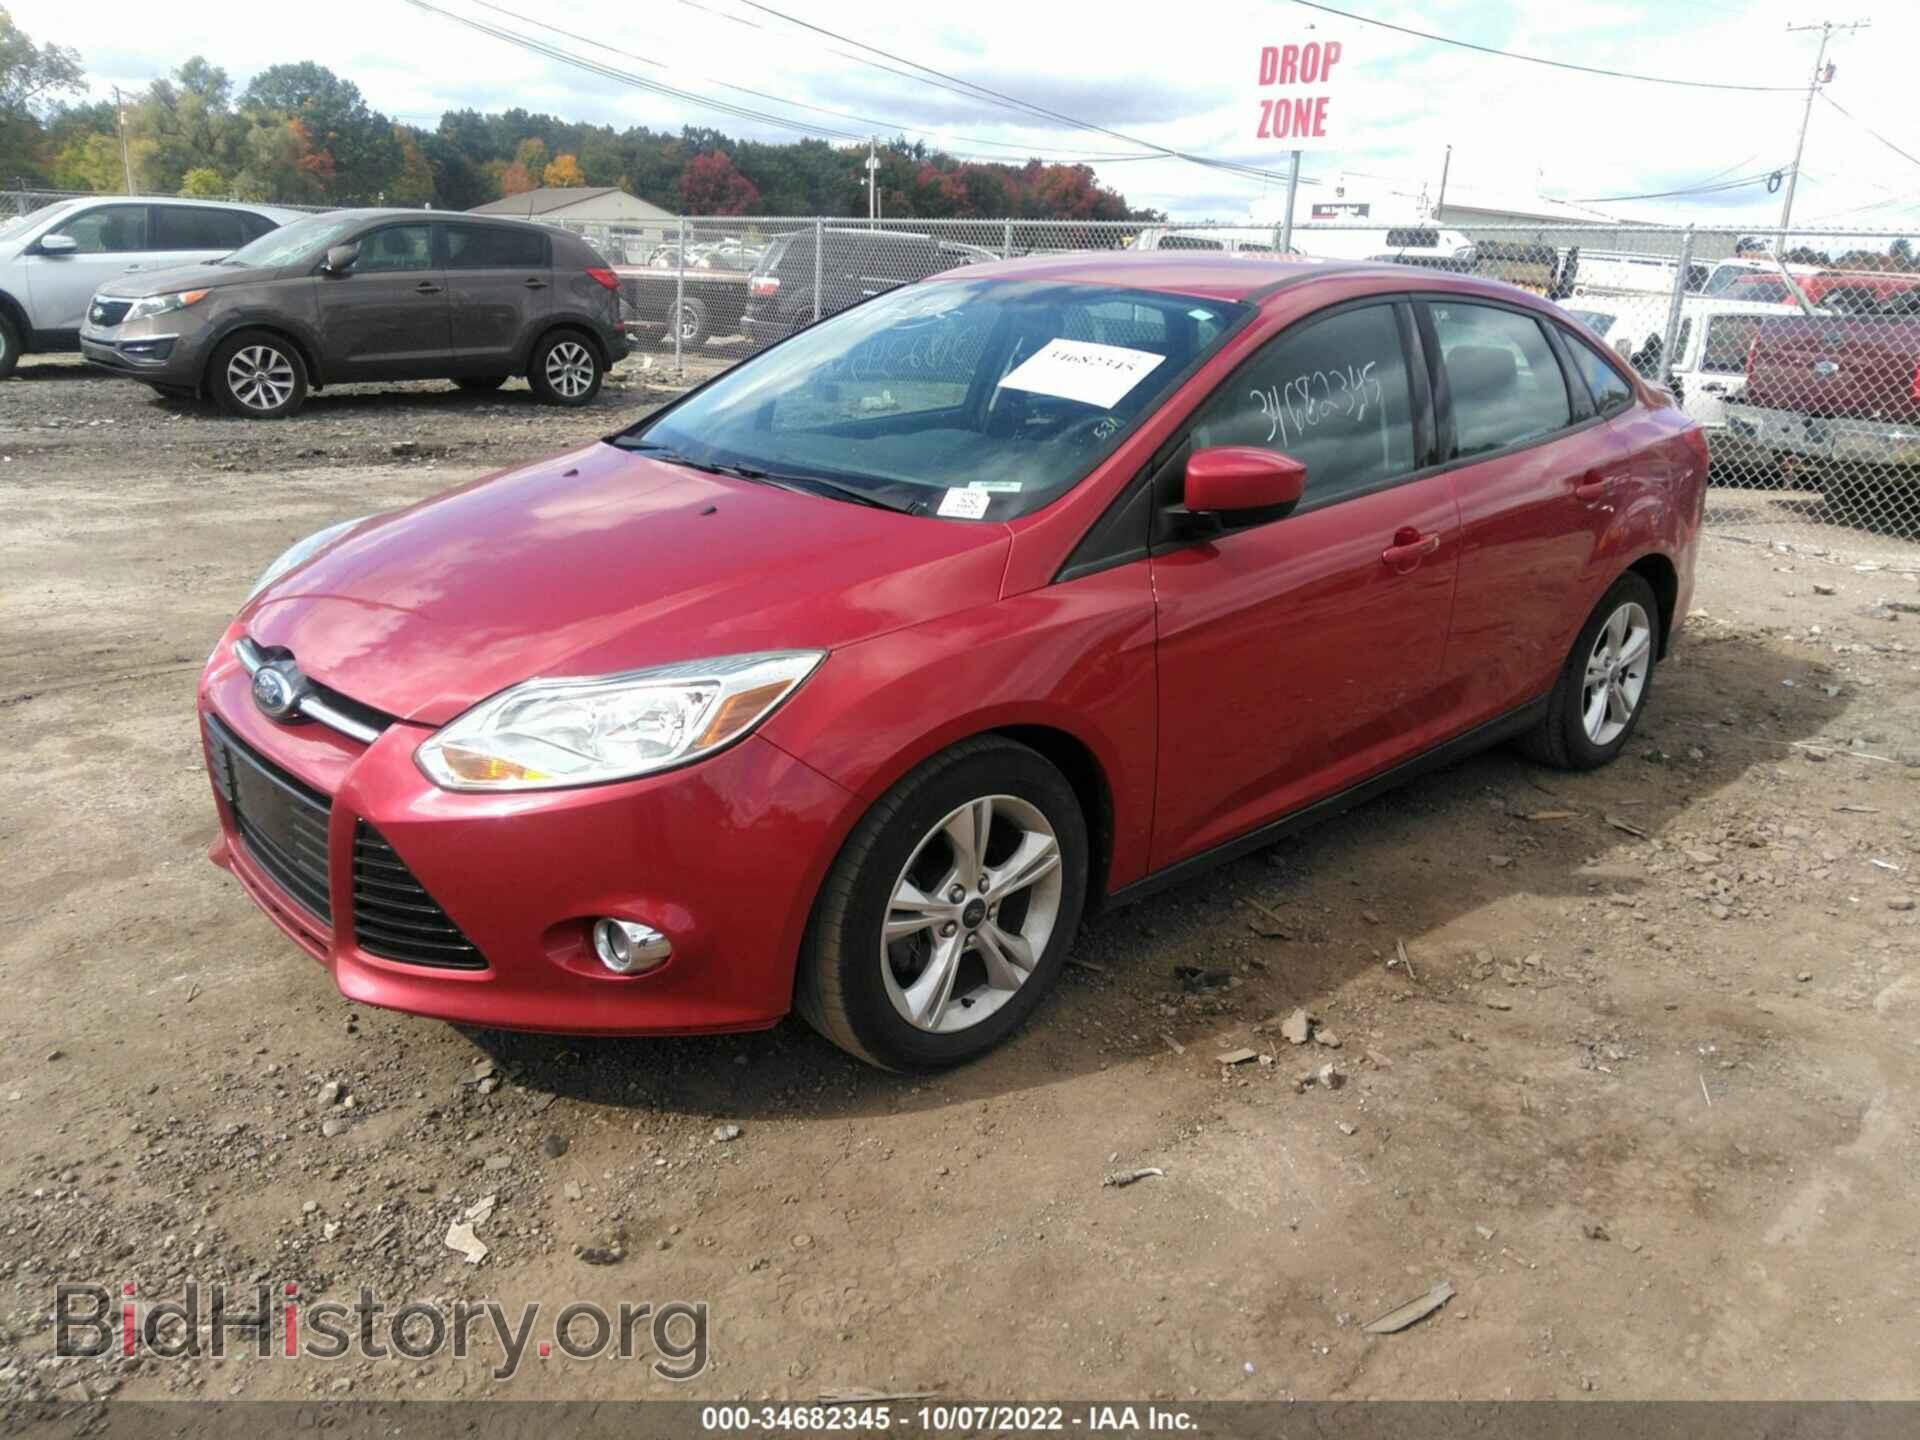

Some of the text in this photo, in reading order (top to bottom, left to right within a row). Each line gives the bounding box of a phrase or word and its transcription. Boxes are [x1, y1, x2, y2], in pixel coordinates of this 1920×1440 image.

[1258, 41, 1342, 86] DROP
[1256, 97, 1330, 139] ZONE
[1250, 360, 1381, 448] 34682345
